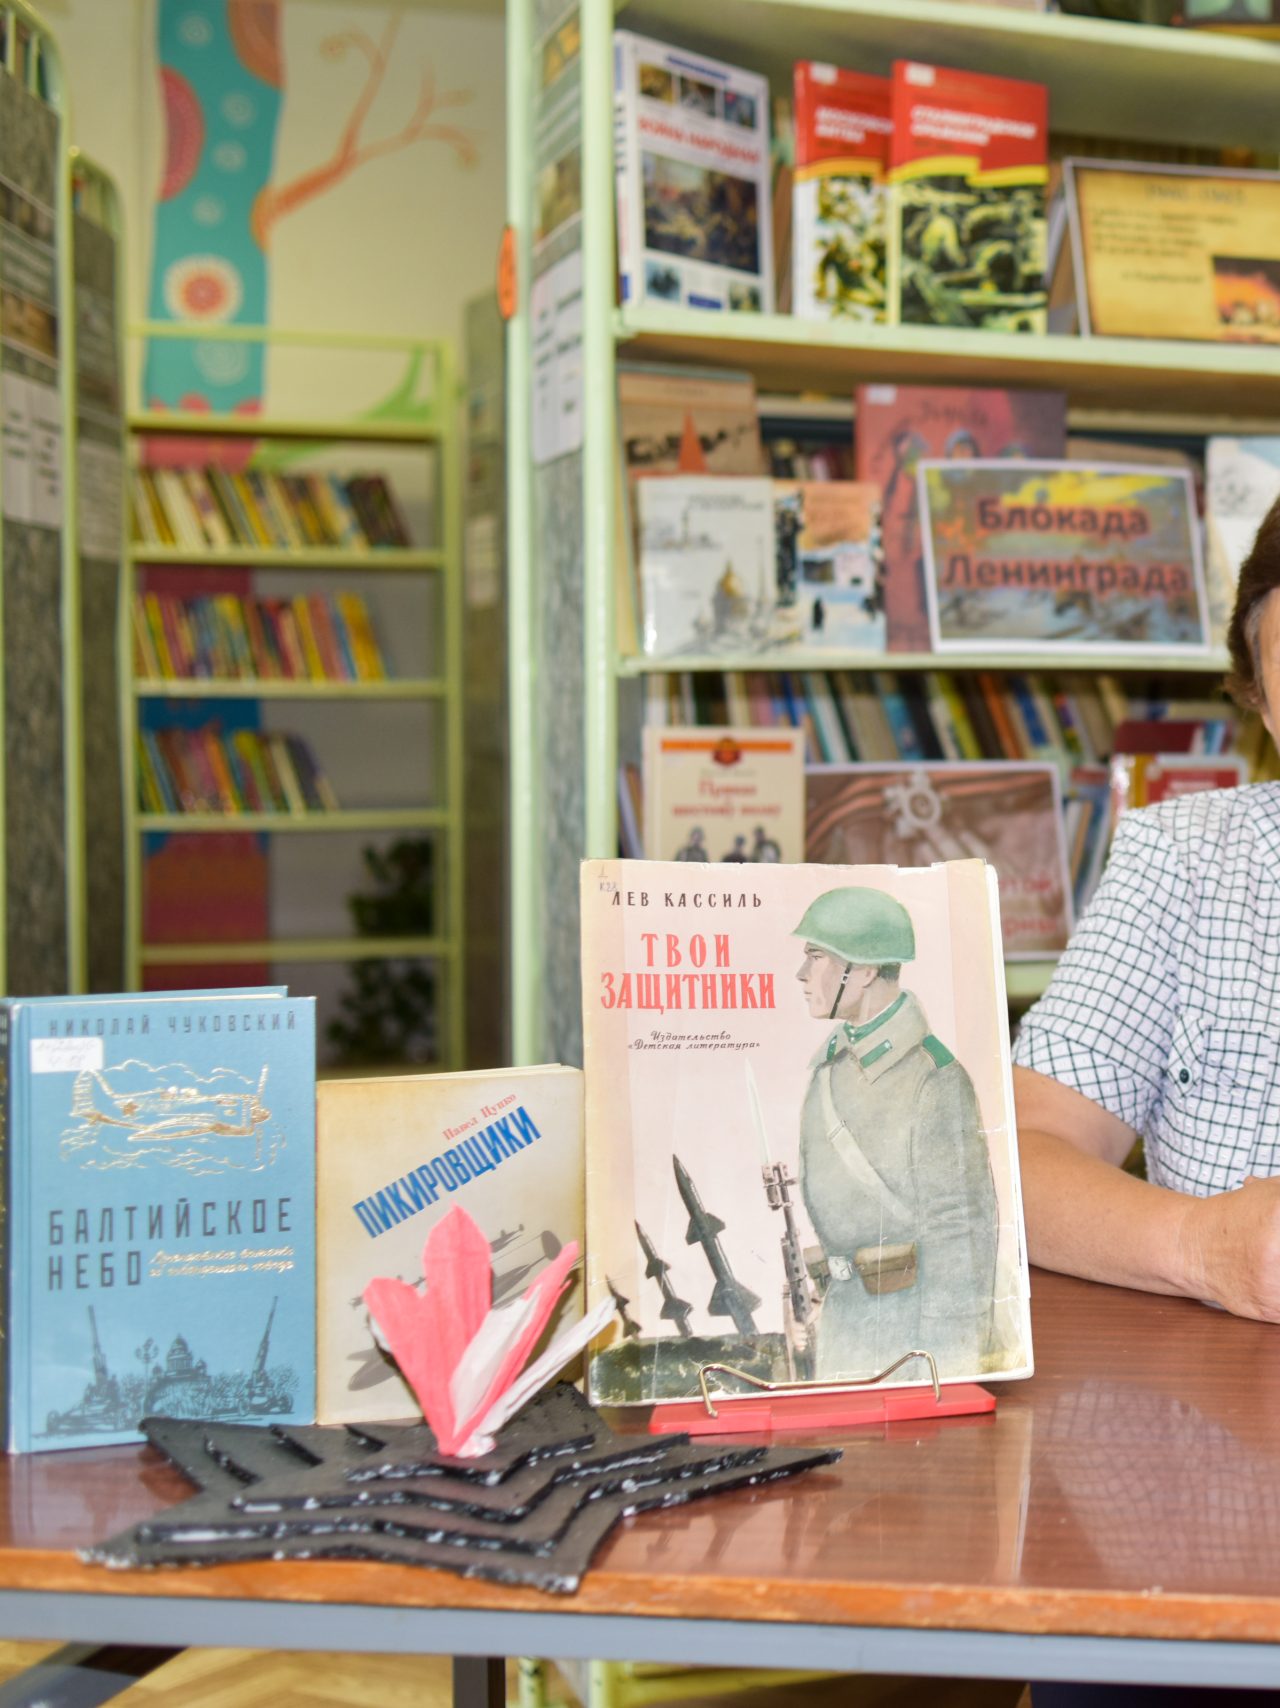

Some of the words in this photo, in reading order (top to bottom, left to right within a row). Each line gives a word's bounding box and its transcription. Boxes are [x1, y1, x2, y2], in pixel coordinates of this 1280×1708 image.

[976, 499, 1150, 538] Блокада
[943, 553, 1194, 596] Ленинграда
[611, 891, 650, 907] ЛЕВ
[664, 892, 763, 908] КАССИЛЬ
[641, 933, 730, 968] ТВОИ
[601, 972, 776, 1014] ЗАЩИТНИКИ
[49, 1014, 151, 1036] НИКОЛАЙ
[168, 1010, 296, 1034] ЧУКОВСКИЙ
[650, 1030, 731, 1042] Издательство
[352, 1105, 542, 1239] ПИКИРОВЩИКИ
[49, 1197, 292, 1246] БАЛТИЙСКОЕ
[49, 1250, 142, 1291] НЕБО
